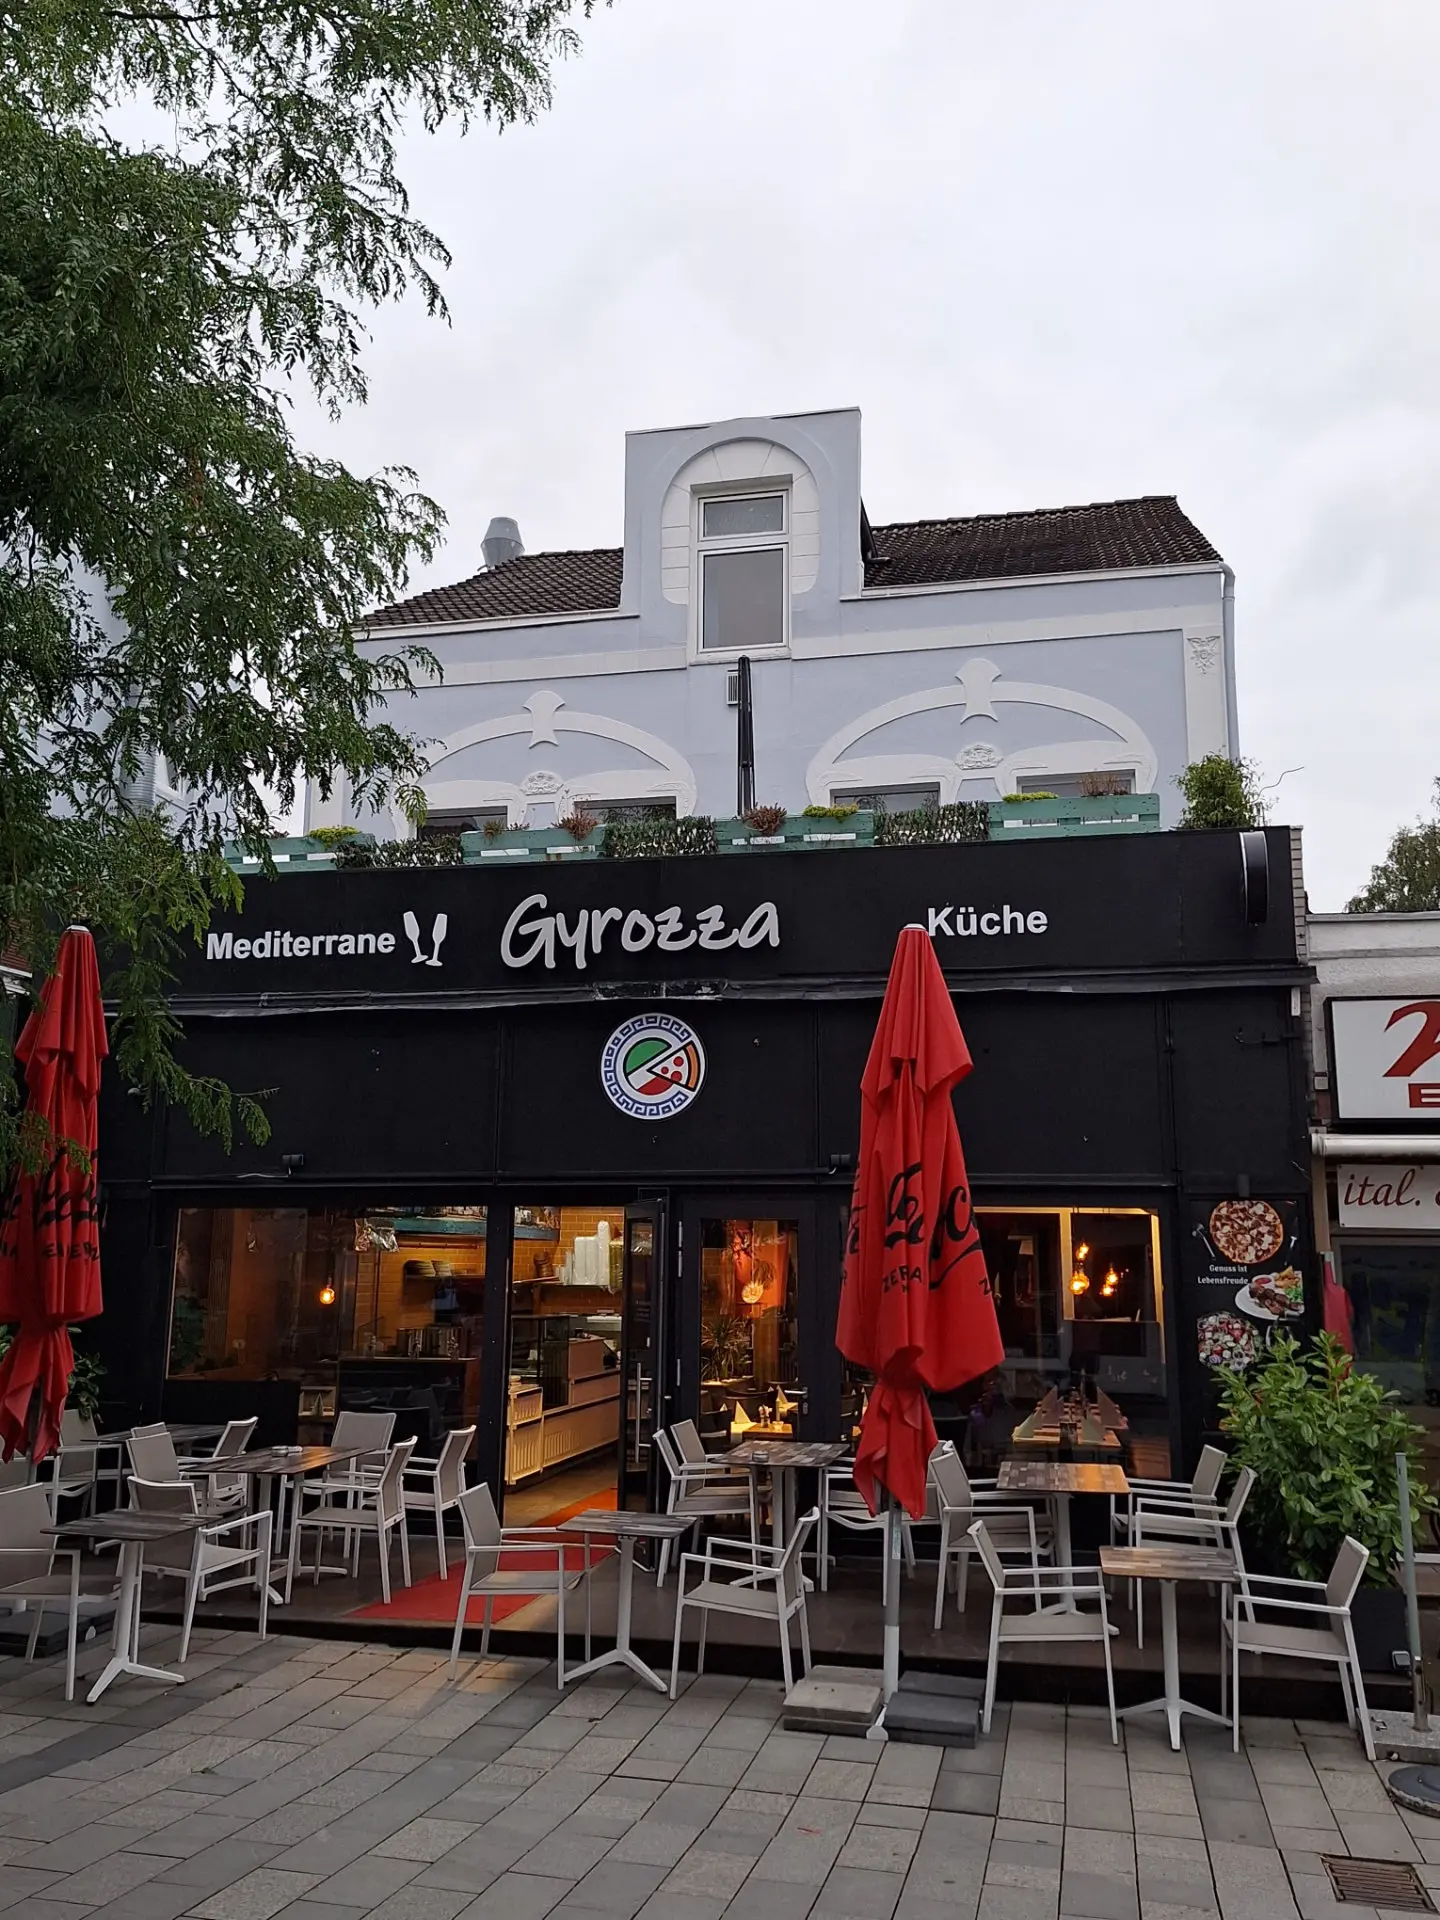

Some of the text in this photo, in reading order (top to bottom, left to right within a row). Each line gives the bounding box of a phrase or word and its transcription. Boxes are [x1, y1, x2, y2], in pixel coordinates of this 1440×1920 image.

[500, 893, 780, 970] Gyrozza
[927, 904, 1049, 937] Küche
[206, 930, 396, 960] Mediterrane
[1343, 1168, 1421, 1207] ital.
[1197, 1276, 1249, 1285] Lebensfreude
[1208, 1264, 1248, 1273] Genuss ist
